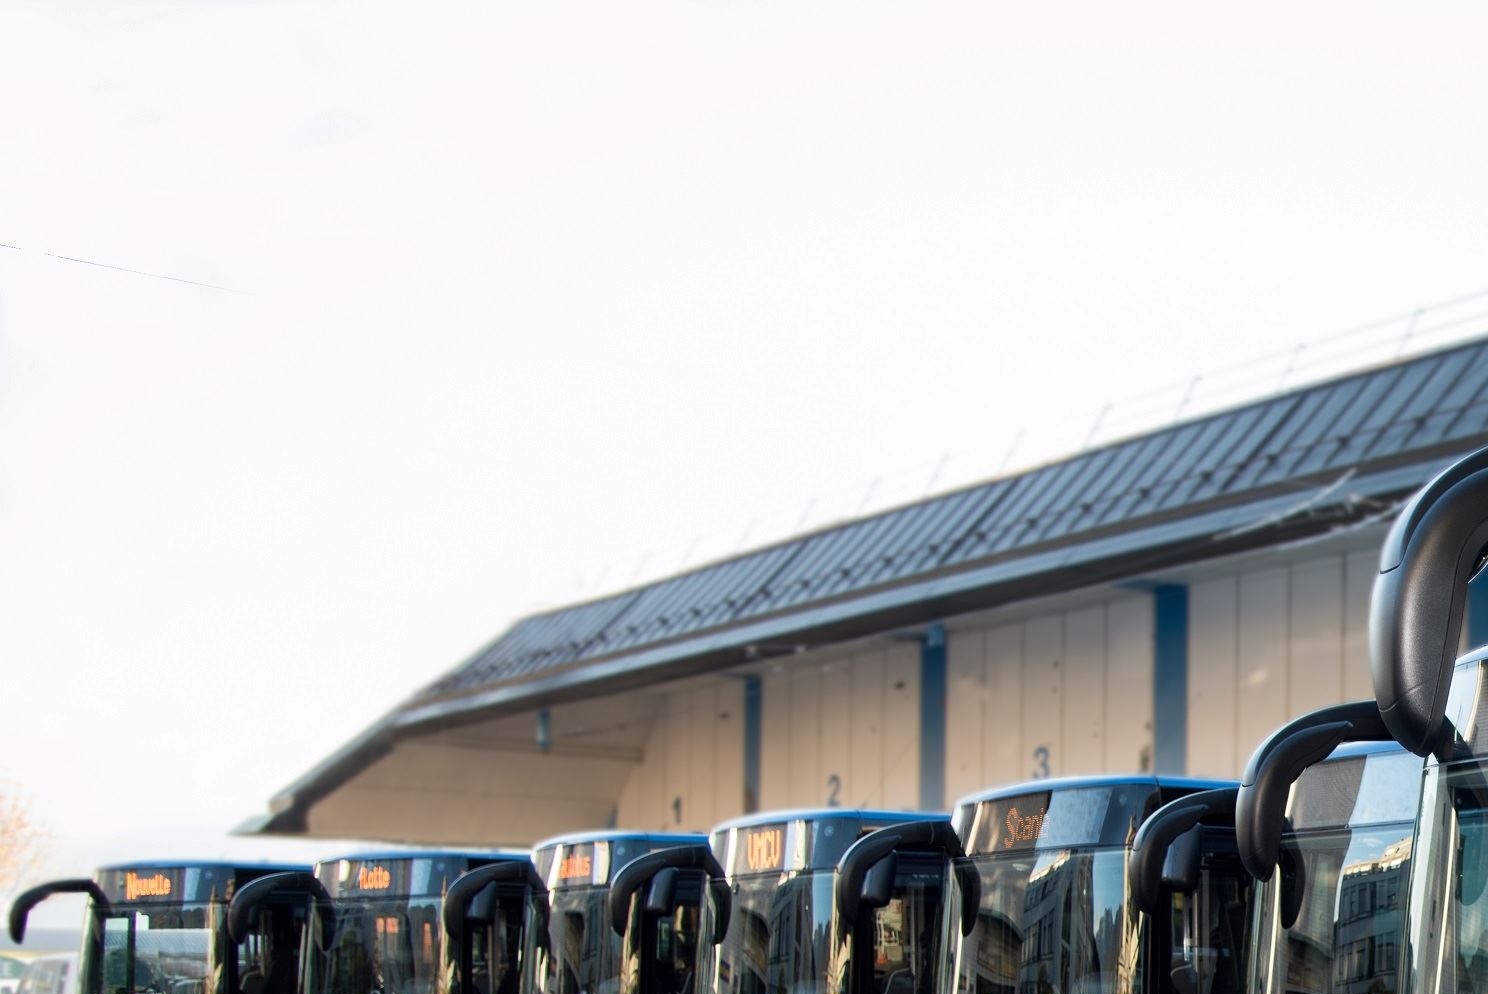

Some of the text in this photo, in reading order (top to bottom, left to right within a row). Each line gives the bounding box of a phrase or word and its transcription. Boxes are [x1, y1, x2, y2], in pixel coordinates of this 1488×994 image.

[1032, 745, 1050, 780] 3
[827, 773, 842, 807] 2
[747, 829, 781, 869] VMCV
